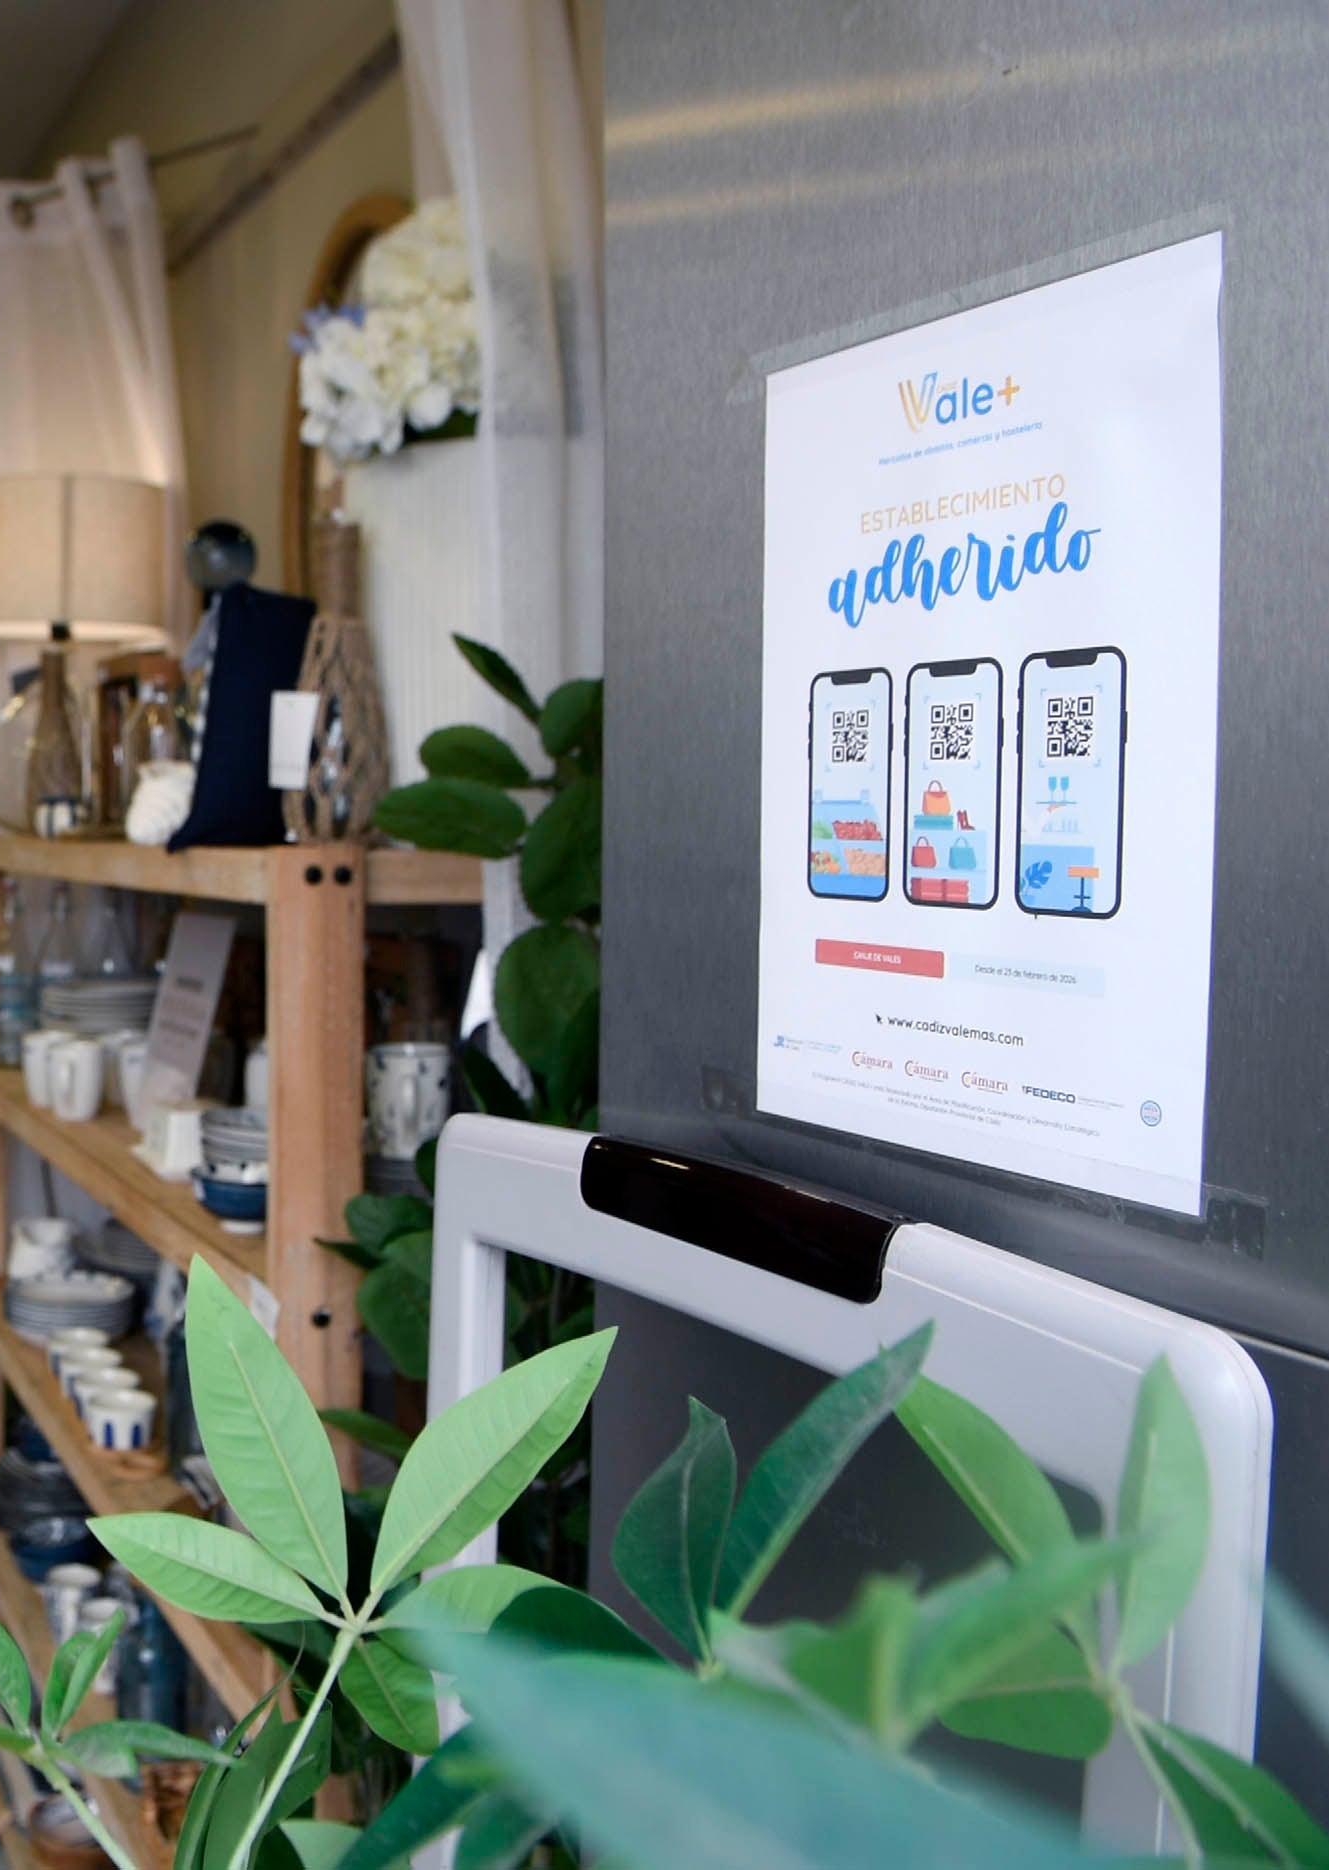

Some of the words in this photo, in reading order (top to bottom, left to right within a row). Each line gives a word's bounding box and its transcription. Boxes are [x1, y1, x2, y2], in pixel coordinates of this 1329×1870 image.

[860, 473, 1066, 534] ESTABLECIMIENTO
[828, 502, 1101, 628] adherido
[975, 964, 995, 975] Desde
[1012, 969, 1022, 978] de
[1023, 970, 1048, 981] febrero
[1049, 973, 1058, 982] de
[887, 1016, 1024, 1047] www.cadizvalemas.com
[852, 1051, 894, 1069] Cámara
[904, 1059, 949, 1079] Cámara
[961, 1071, 1009, 1091] Cámara
